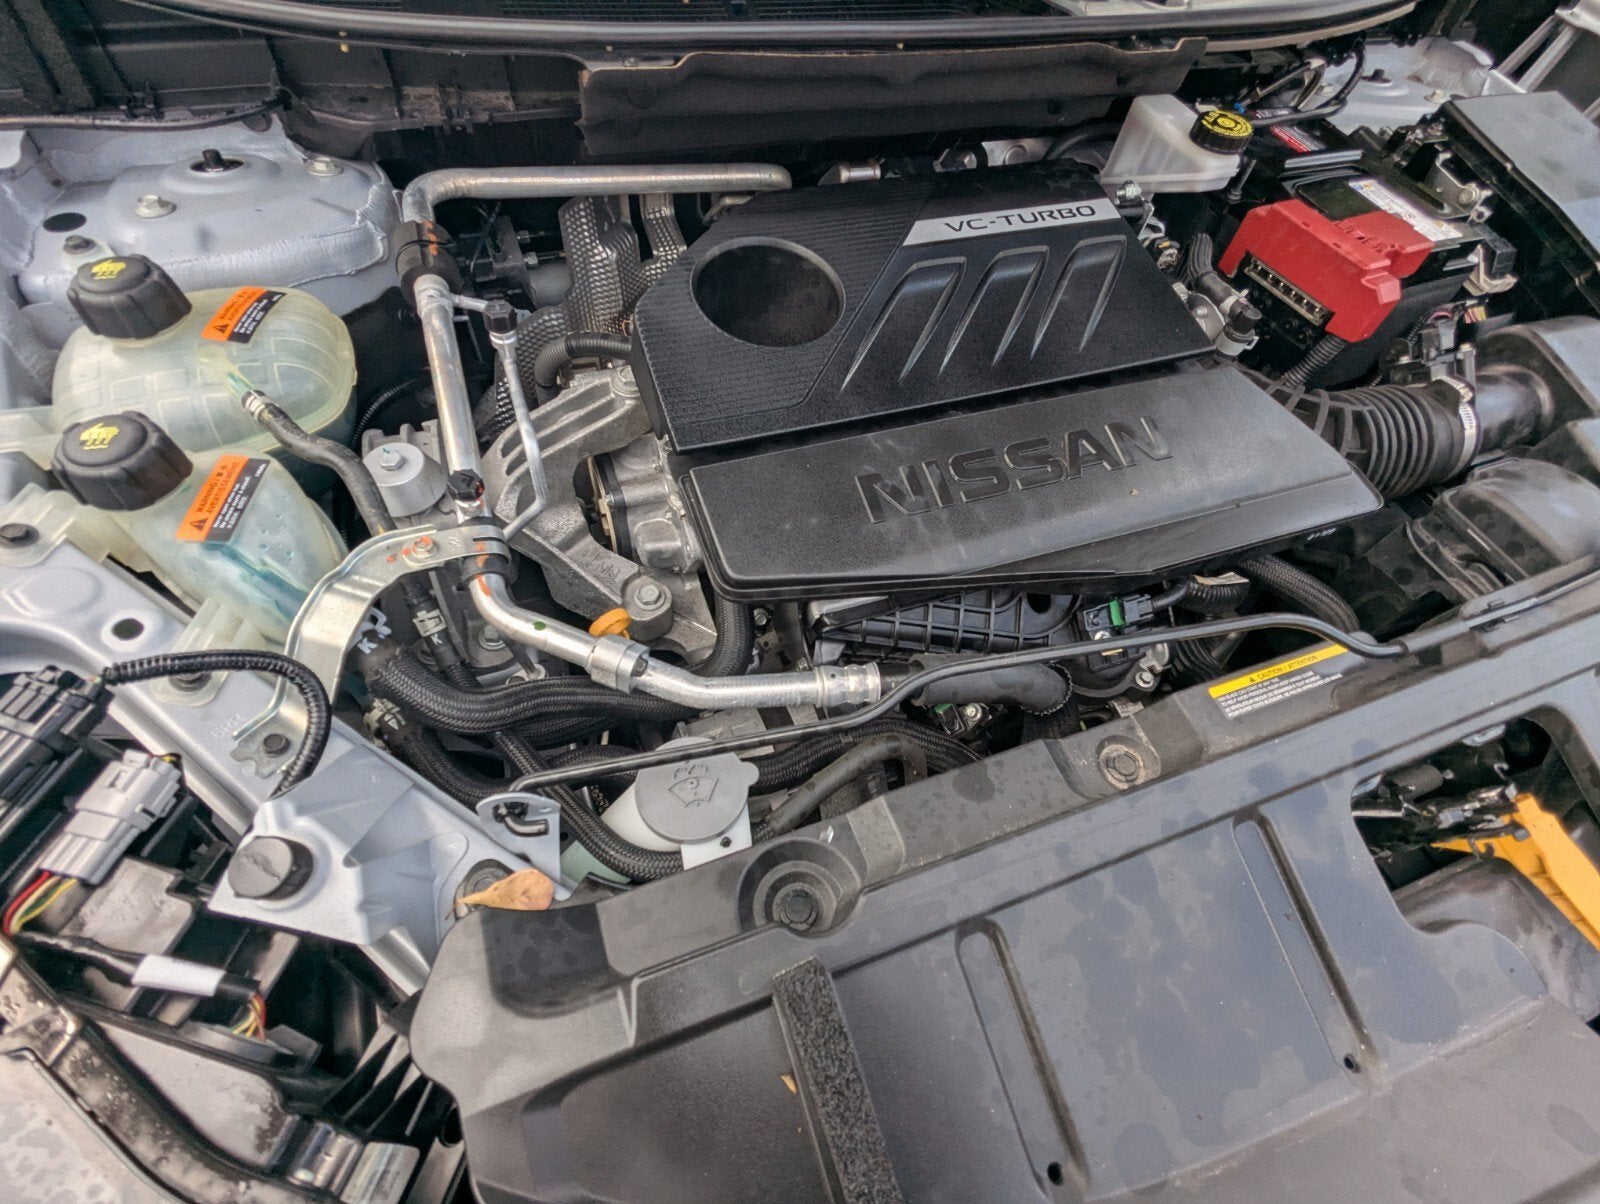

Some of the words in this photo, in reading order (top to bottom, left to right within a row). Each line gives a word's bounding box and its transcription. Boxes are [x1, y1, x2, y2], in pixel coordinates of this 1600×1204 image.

[944, 205, 1096, 232] VC-TURBO
[855, 416, 1173, 524] NISSAN
[1257, 667, 1283, 679] CAUTION
